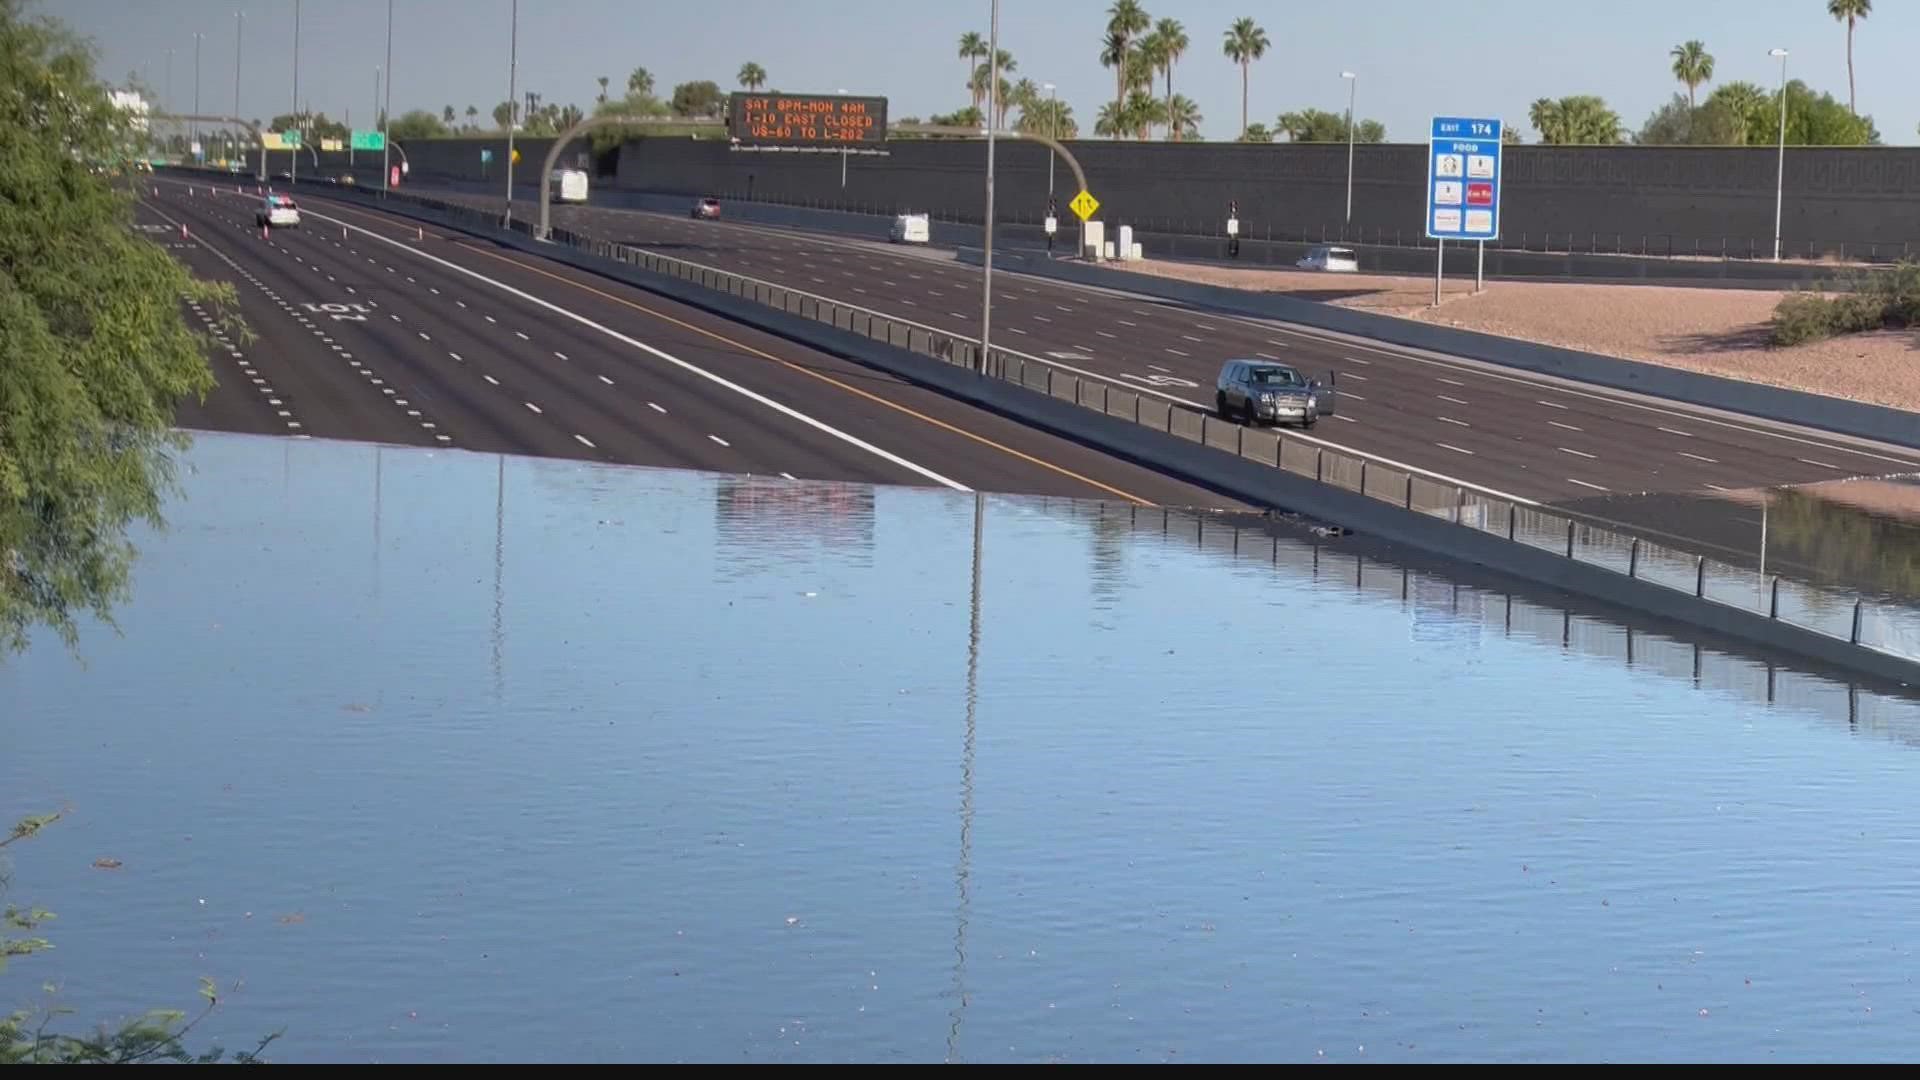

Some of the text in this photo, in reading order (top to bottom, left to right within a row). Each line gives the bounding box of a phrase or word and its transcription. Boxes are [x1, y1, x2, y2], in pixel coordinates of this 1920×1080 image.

[745, 98, 769, 110] SAT
[841, 103, 865, 114] 4AM
[745, 112, 873, 127] I-10 EAST CLOSED
[752, 127, 865, 140] US-60 TO L-202
[1440, 123, 1492, 136] EXIT 174
[1453, 143, 1479, 153] FOOD
